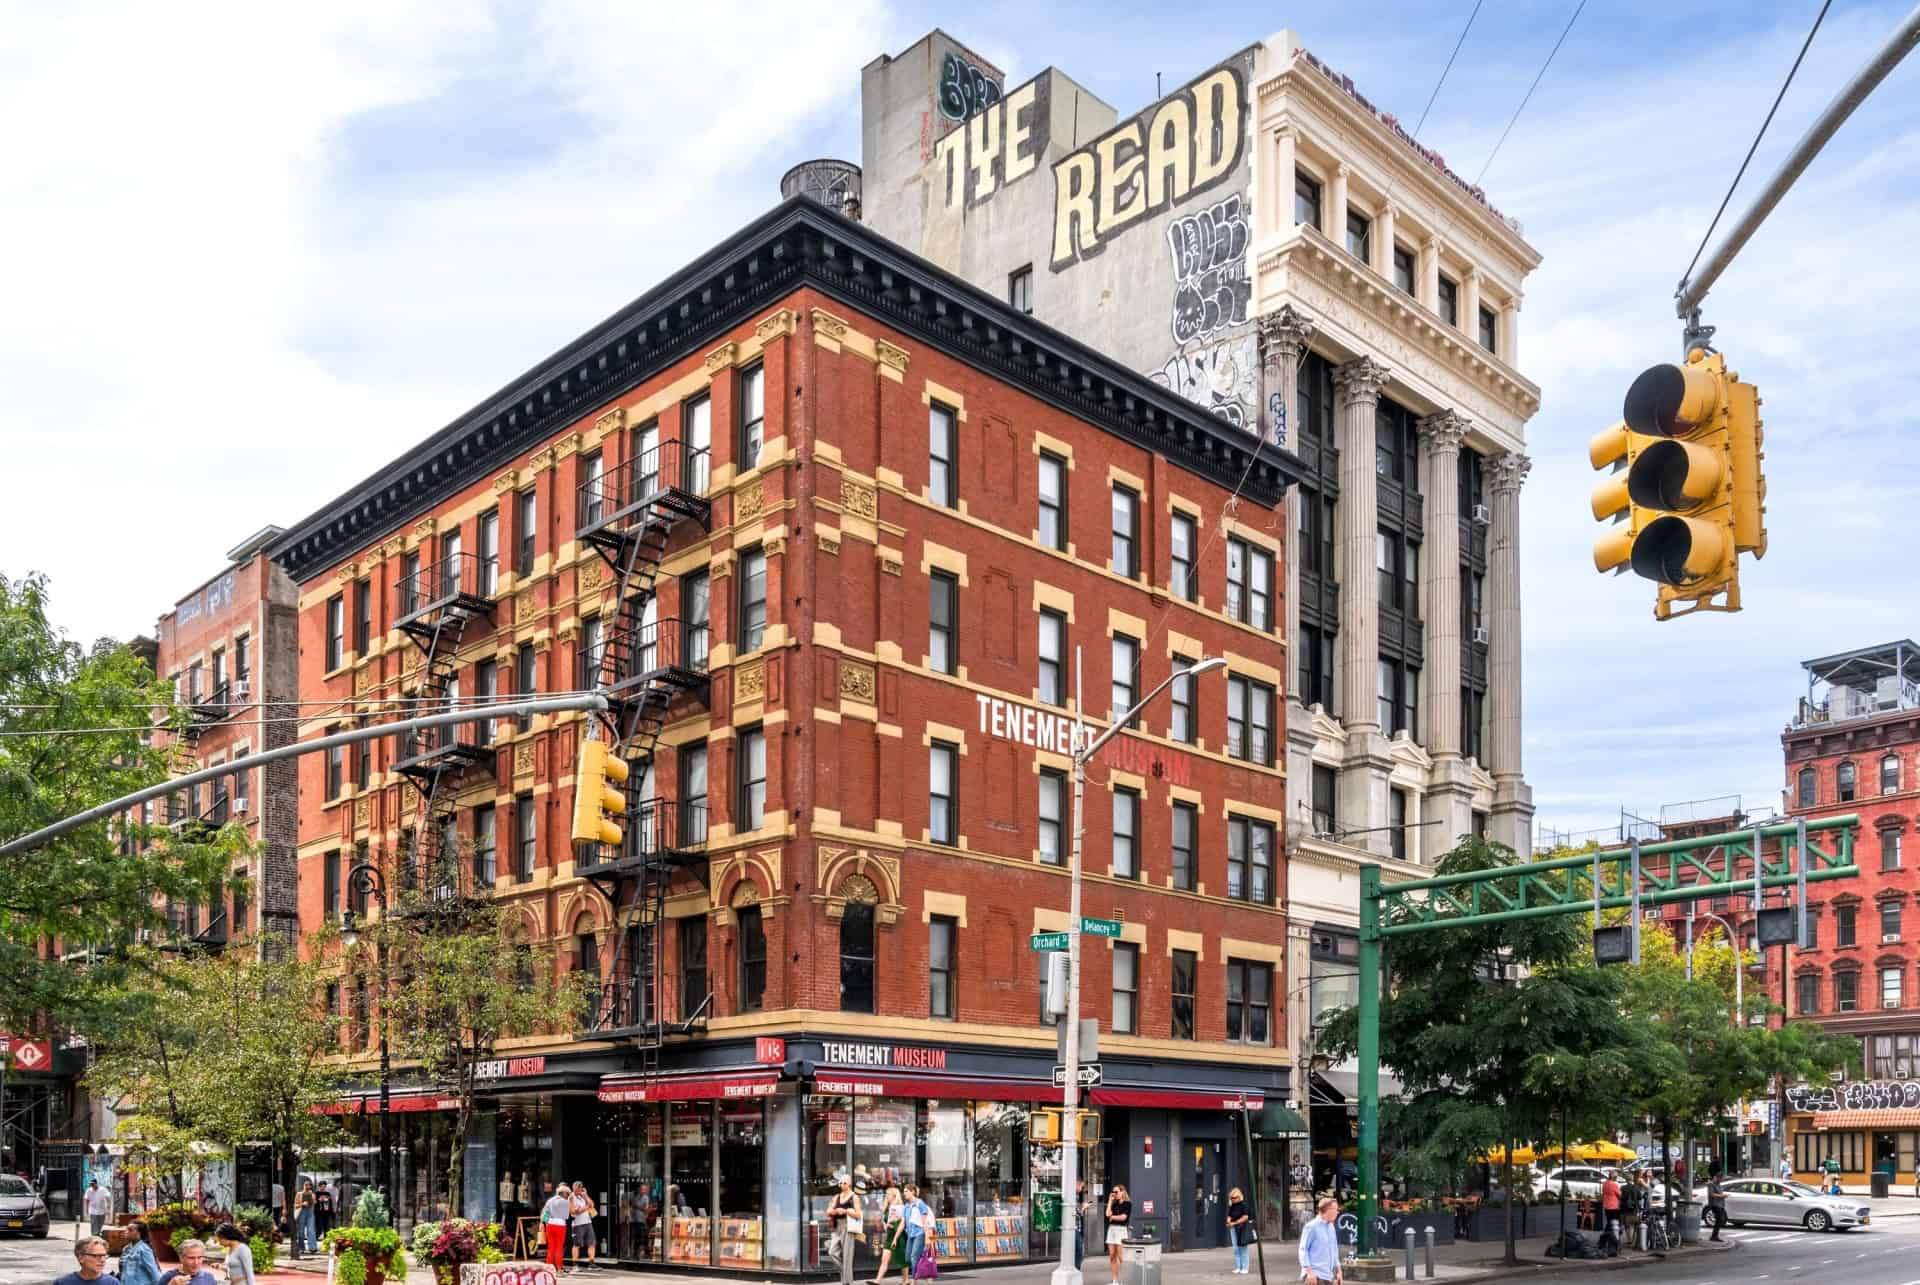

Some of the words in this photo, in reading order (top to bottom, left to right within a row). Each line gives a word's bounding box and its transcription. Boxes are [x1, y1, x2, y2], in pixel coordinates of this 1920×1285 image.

[1051, 66, 1242, 266] READ
[976, 693, 1097, 762] TENEMENT
[1085, 919, 1110, 936] Delancey
[1033, 935, 1060, 949] Orchard
[822, 1042, 890, 1065] TENEMENT
[893, 1047, 946, 1069] MUSEUM
[508, 1056, 545, 1075] MUSEUM
[1080, 1071, 1096, 1080] WAY
[817, 1080, 852, 1095] TENEMENT
[854, 1082, 884, 1096] MUSEUM
